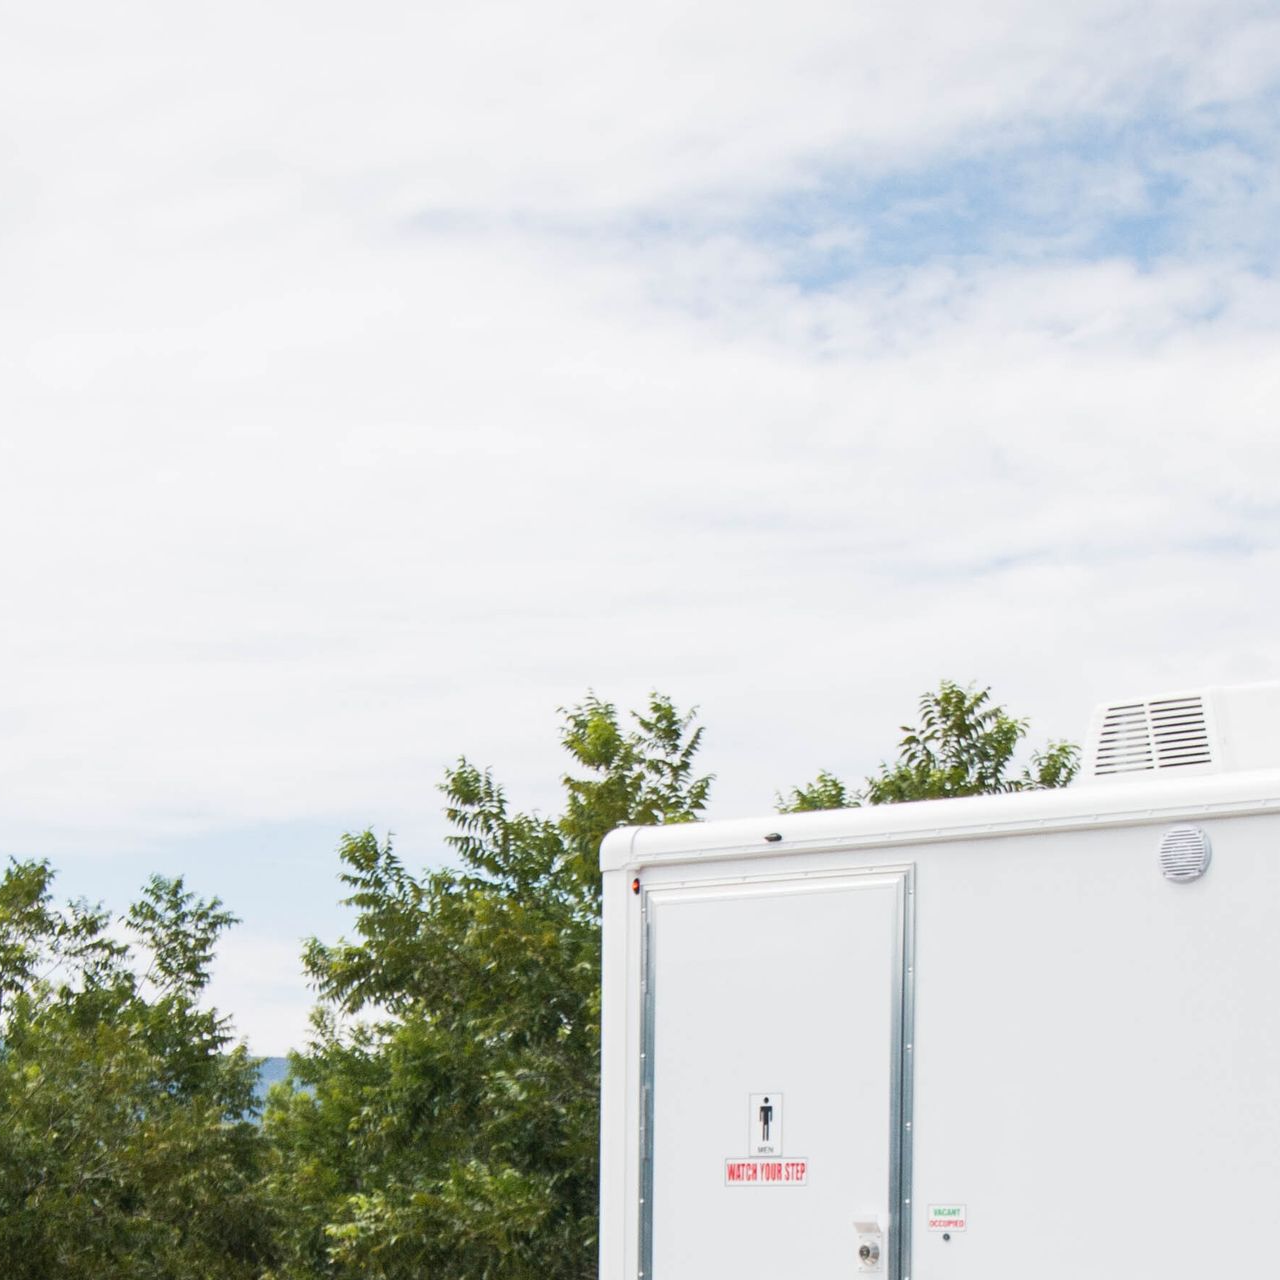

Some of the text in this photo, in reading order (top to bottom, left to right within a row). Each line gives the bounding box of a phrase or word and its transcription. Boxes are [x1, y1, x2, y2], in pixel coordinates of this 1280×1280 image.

[727, 1162, 805, 1181] WATCH YOUR STEP
[933, 1208, 960, 1216] VACANT
[929, 1219, 964, 1227] OCCUPIED
